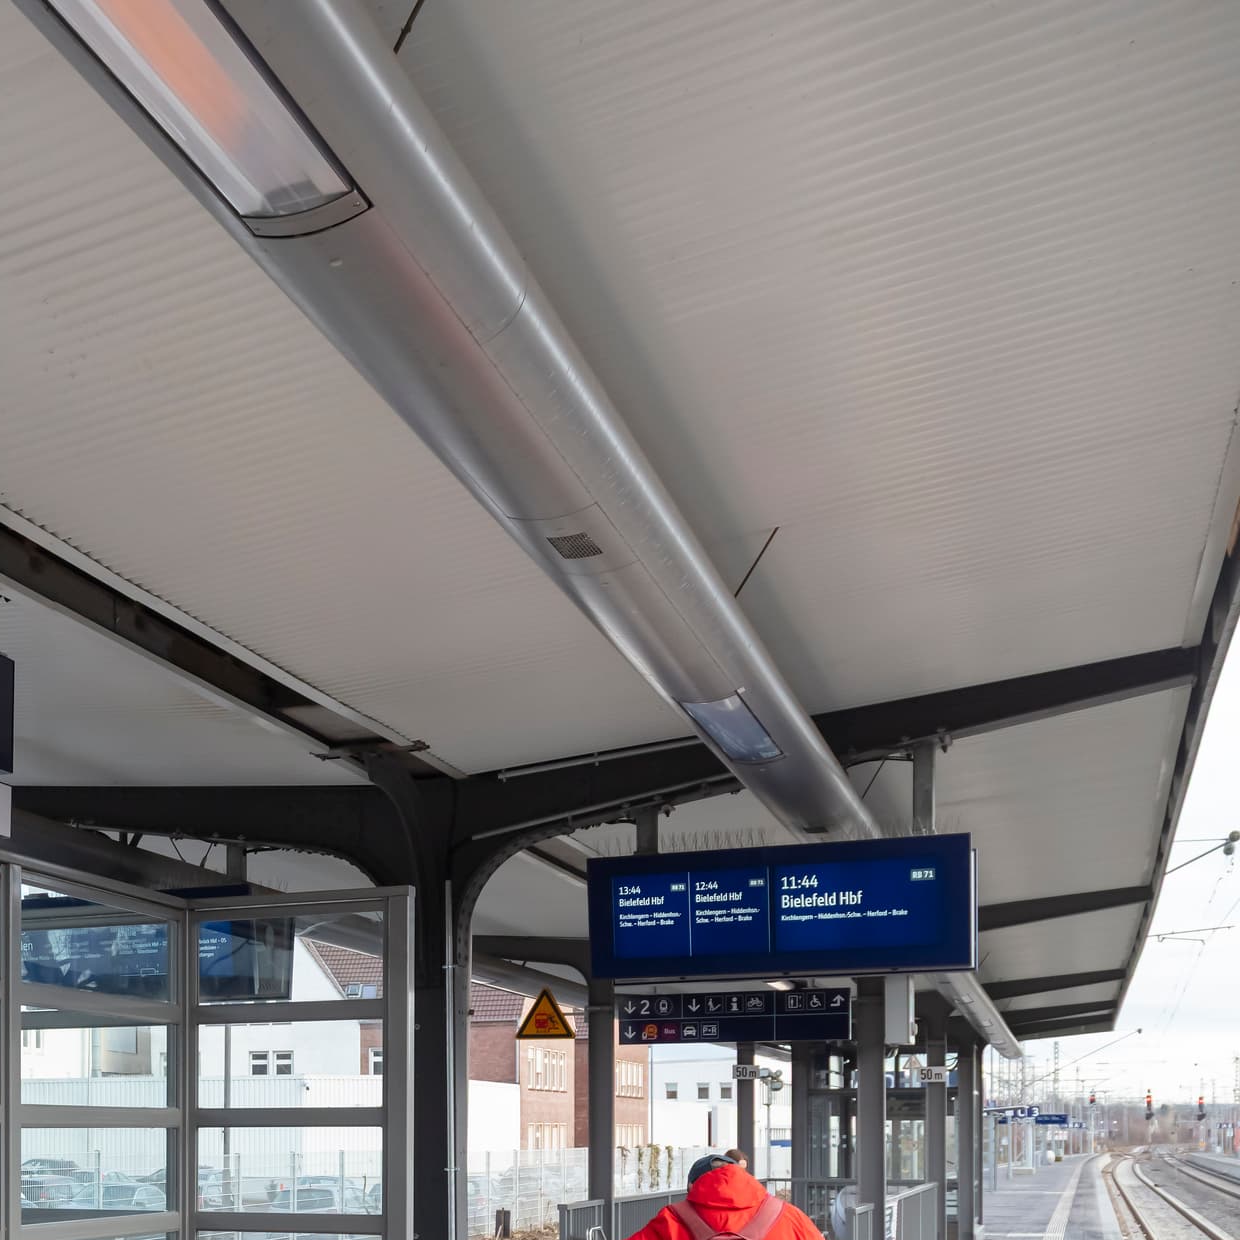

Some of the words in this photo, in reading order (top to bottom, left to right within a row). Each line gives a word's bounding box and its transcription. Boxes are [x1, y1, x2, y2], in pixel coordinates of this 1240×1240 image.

[912, 871, 922, 879] RB
[923, 870, 934, 878] 71
[695, 881, 718, 890] 12:44
[781, 875, 818, 890] 11:44
[619, 886, 641, 895] 13:44
[619, 897, 650, 907] Bielefeld
[651, 896, 664, 905] Hbf
[695, 893, 728, 903] Bielefeld
[729, 891, 742, 901] Hbf
[781, 892, 836, 908] Bielefeld
[840, 890, 863, 905] Hbf
[640, 1000, 650, 1015] 2
[736, 1066, 747, 1077] 50
[749, 1070, 756, 1078] m
[920, 1069, 932, 1080] 50
[934, 1072, 942, 1080] m
